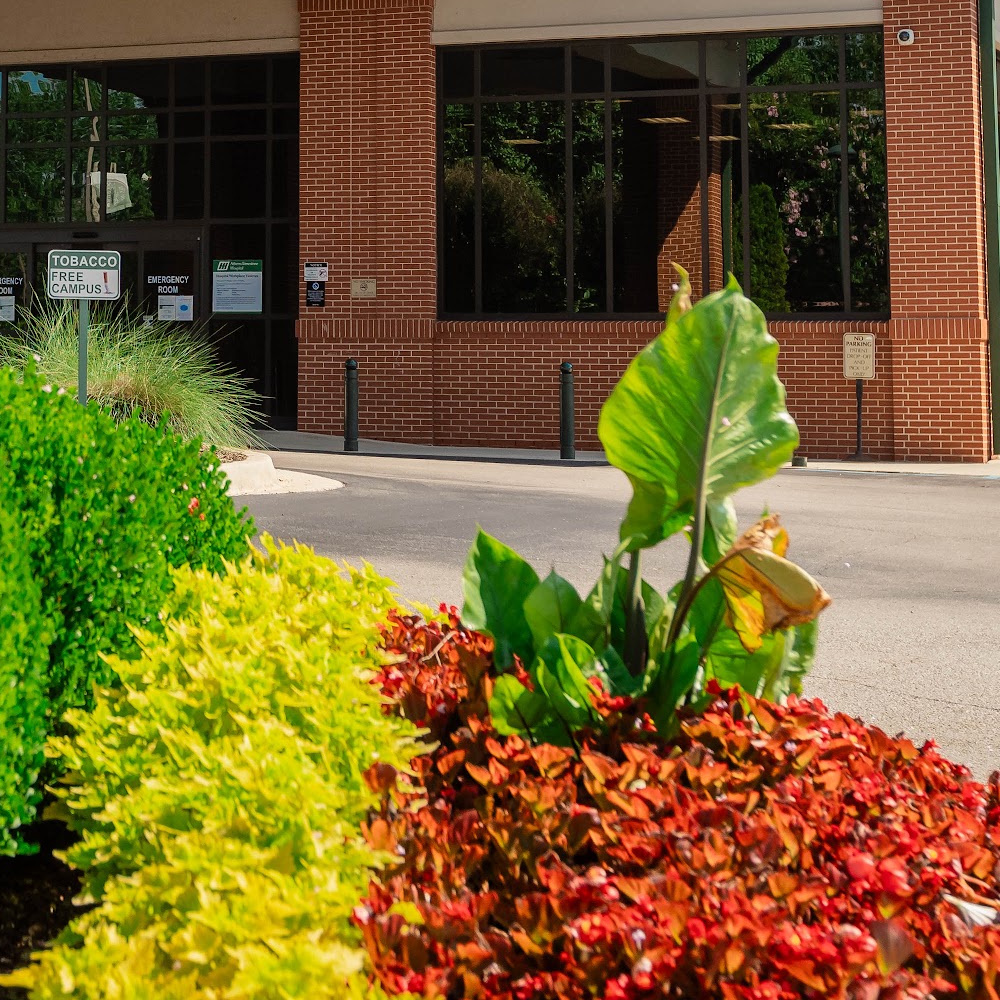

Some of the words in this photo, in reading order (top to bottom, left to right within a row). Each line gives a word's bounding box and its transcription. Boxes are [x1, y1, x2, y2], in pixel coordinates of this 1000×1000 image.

[51, 255, 117, 268] TOBACCO
[51, 271, 84, 282] FREE
[147, 275, 190, 284] EMERGENCY
[51, 283, 102, 294] CAMPUS
[157, 285, 179, 294] ROOM
